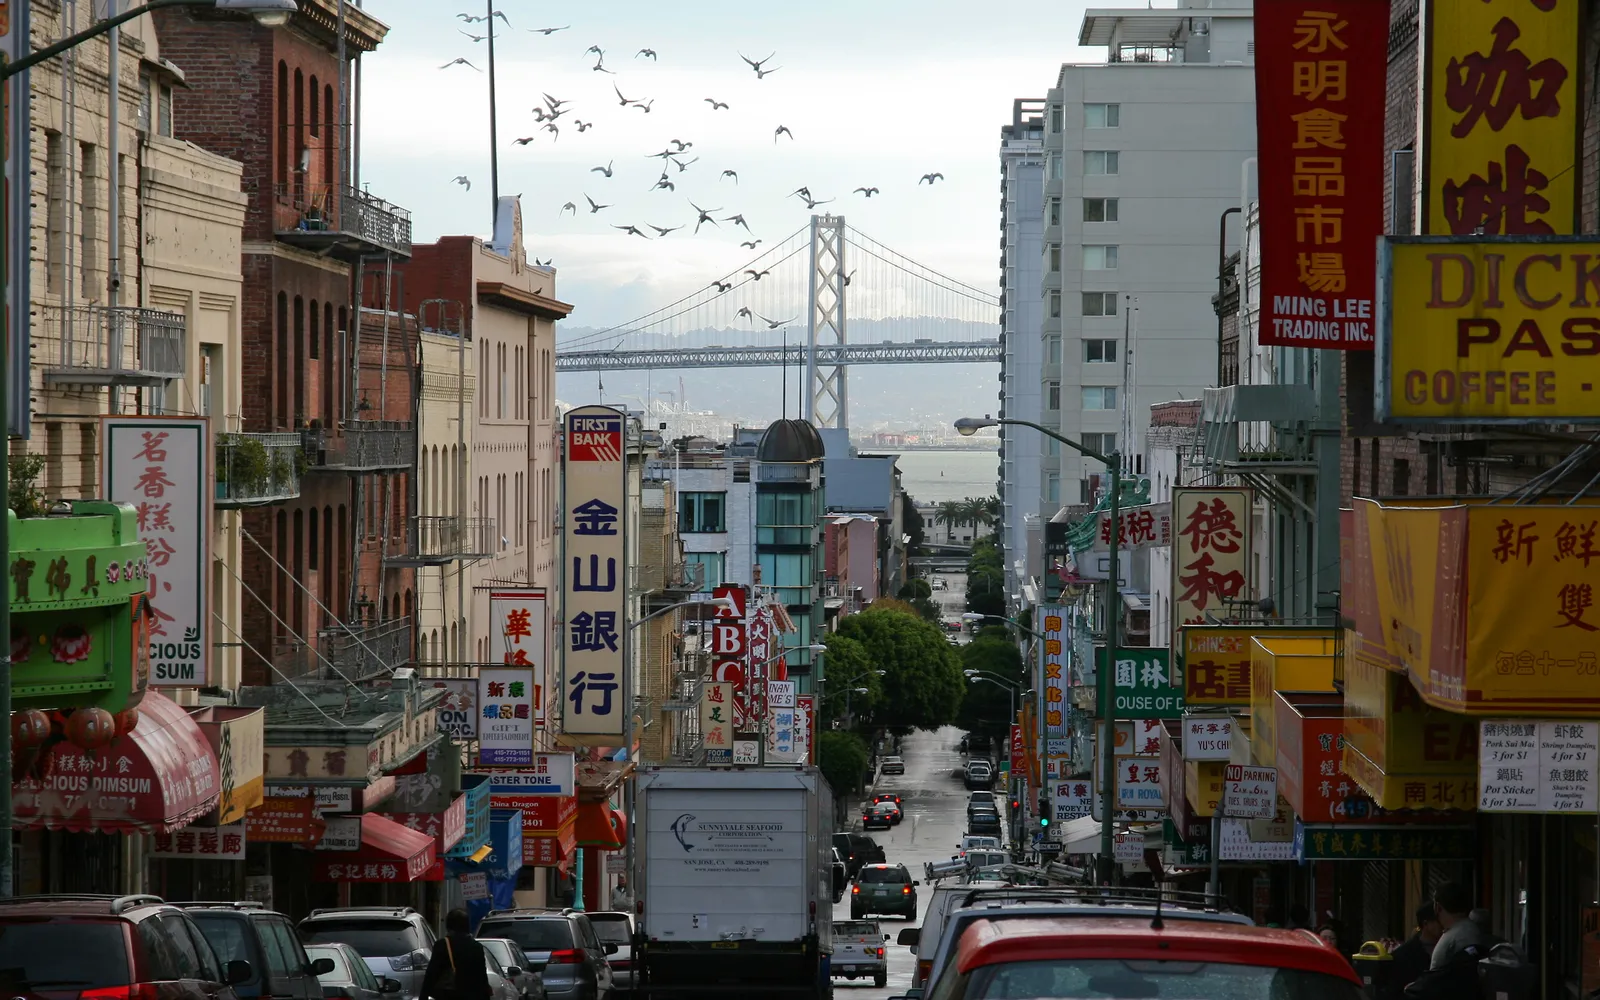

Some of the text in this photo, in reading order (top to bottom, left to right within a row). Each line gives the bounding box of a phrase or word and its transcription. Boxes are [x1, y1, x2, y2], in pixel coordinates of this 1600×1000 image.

[1291, 11, 1349, 293] 永明食品市場
[1273, 296, 1371, 319] MING LEE
[1273, 319, 1374, 342] TRADING INC.
[1405, 369, 1556, 405] COFFEE
[573, 418, 609, 431] FIRST
[1492, 518, 1600, 569] 新鮮
[1176, 498, 1245, 633] 德和
[570, 498, 619, 716] 金山銀行
[156, 663, 194, 679] SUM
[1115, 658, 1169, 690] 園林
[1155, 697, 1173, 710] OF
[1198, 741, 1215, 750] YU'S
[1541, 742, 1565, 750] Shrimp
[1492, 751, 1528, 761] 3 for $1
[1558, 752, 1574, 762] for
[1575, 752, 1587, 760] $1
[523, 776, 551, 784] TONE
[1126, 763, 1160, 784] 皇冠
[1227, 766, 1240, 780] NO
[1243, 771, 1275, 782] PARKING
[92, 777, 151, 793] DIMSUM
[1485, 785, 1535, 795] Pot Sticker
[1481, 798, 1487, 807] 8
[1488, 798, 1504, 809] for
[1506, 798, 1517, 807] $1
[1559, 801, 1574, 809] for
[1576, 801, 1584, 809] $1
